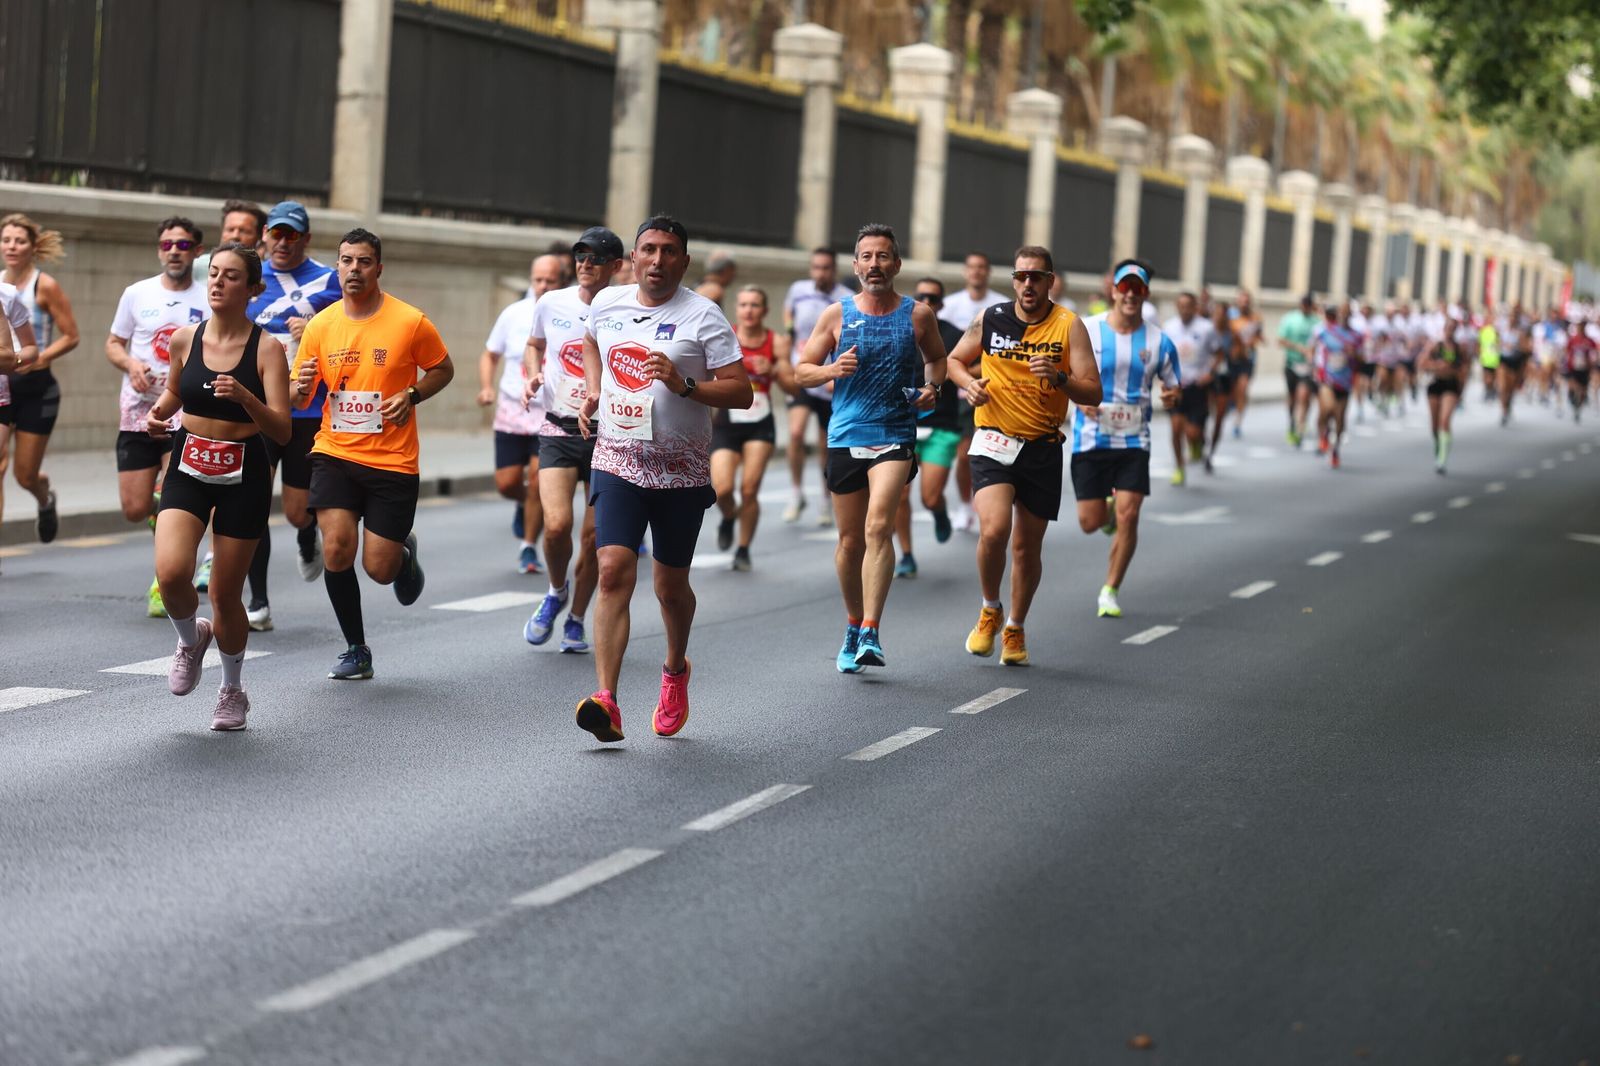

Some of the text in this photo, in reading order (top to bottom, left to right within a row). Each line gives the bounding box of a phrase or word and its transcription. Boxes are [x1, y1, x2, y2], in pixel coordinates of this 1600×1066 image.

[990, 332, 1063, 353] bichos
[990, 348, 1062, 363] runns
[338, 402, 374, 413] 1200
[610, 402, 643, 418] 1302
[984, 432, 1009, 447] 511
[189, 447, 235, 465] 2413
